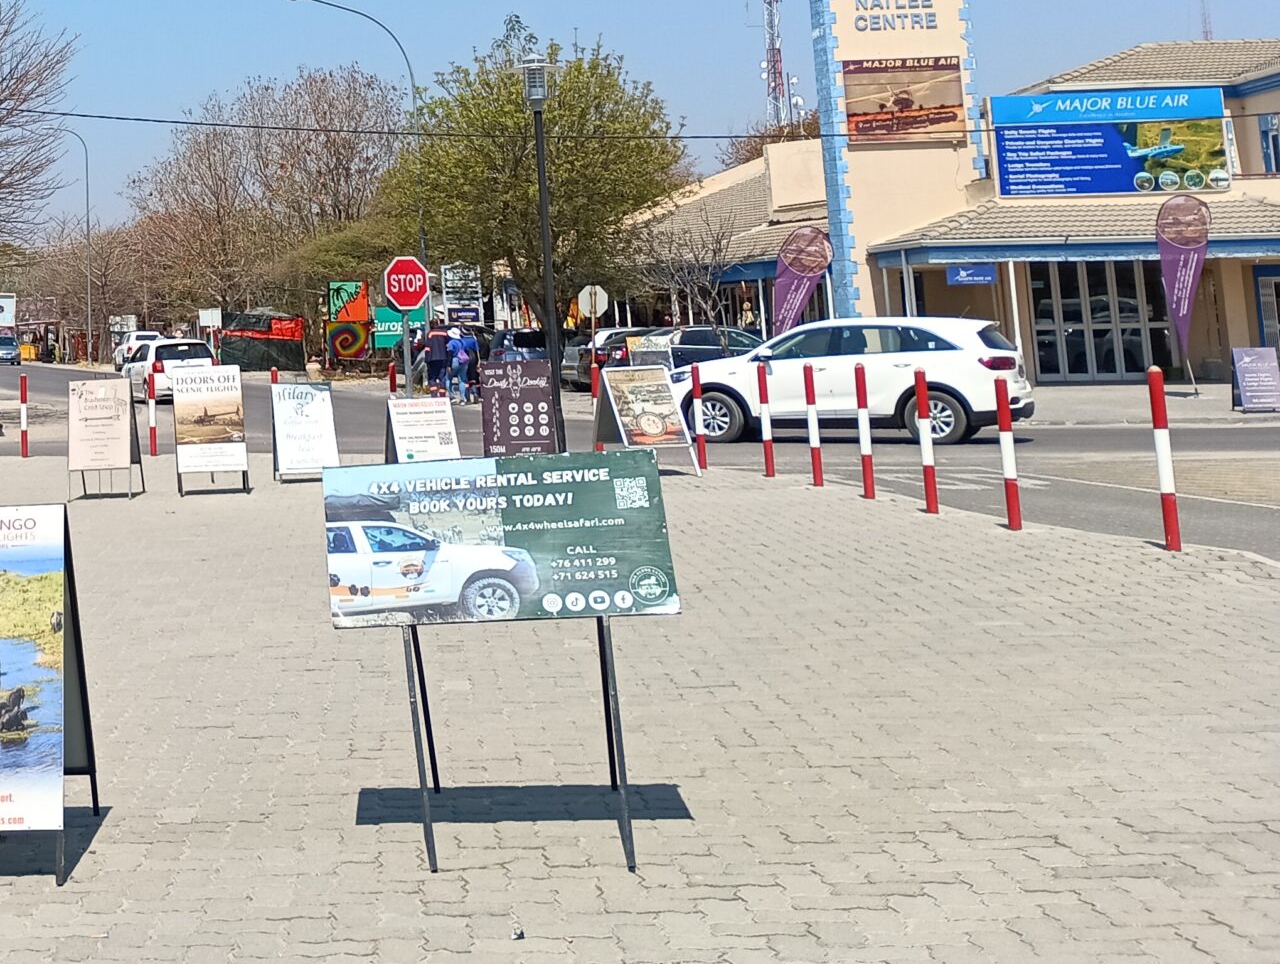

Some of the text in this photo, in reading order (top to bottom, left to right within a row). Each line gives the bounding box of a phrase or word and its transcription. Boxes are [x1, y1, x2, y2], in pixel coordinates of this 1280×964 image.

[854, 12, 938, 31] CENTRE
[863, 57, 959, 68] MAJOR BLUE AIR
[1055, 94, 1189, 113] MAJOR BLUE AIR
[390, 274, 424, 293] STOP
[374, 320, 425, 333] uropa
[176, 374, 236, 386] DOORS OFF
[484, 376, 549, 389] Dusty Donkey
[176, 384, 238, 394] SCENIC FLIGHTS
[489, 445, 506, 453] 150M
[369, 467, 610, 495] 4X4 VEHICLE RENTAL SERVICE
[409, 492, 573, 515] BOOK YOURS TODAY!
[566, 545, 597, 555] CALL
[551, 556, 617, 569] +76 411 299
[552, 569, 618, 581] +71 624 515
